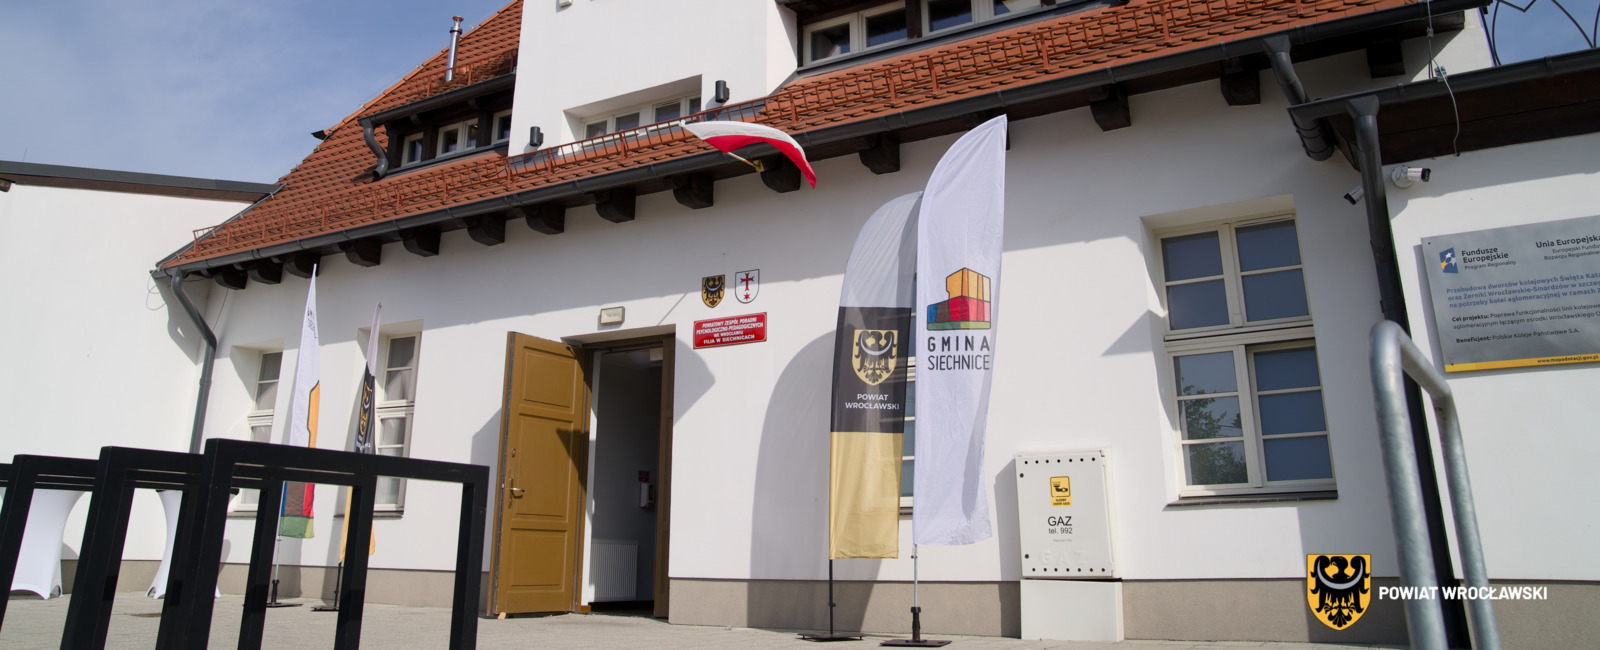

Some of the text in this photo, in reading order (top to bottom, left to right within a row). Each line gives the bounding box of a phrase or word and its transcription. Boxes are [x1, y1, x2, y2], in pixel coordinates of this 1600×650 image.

[1462, 248, 1498, 256] Fundusze
[1552, 246, 1580, 254] Europejski
[1463, 252, 1508, 264] Europejskie
[1487, 260, 1516, 268] Regionalny
[1446, 285, 1486, 294] Przebudowa
[1488, 281, 1518, 290] dworców
[1519, 276, 1558, 286] kolejowych
[1560, 274, 1584, 282] Święta
[1488, 284, 1569, 296] Wrocławskie-Smardzów
[1458, 300, 1488, 309] potrzeby
[1508, 291, 1560, 302] aglomeracyjnej
[1462, 314, 1489, 322] projektu:
[1516, 306, 1561, 316] funkcjonalności
[1454, 321, 1498, 330] aglomeracyjnym
[1548, 312, 1595, 320] Wrocławskiego
[722, 334, 755, 342] SIECHNICACH
[928, 336, 990, 352] GMINA
[928, 354, 990, 370] SIECHNICE
[1537, 354, 1599, 363] www.mapadotacji.gov.pl
[845, 402, 900, 410] WROCŁAWSKI
[1048, 516, 1072, 526] GAZ
